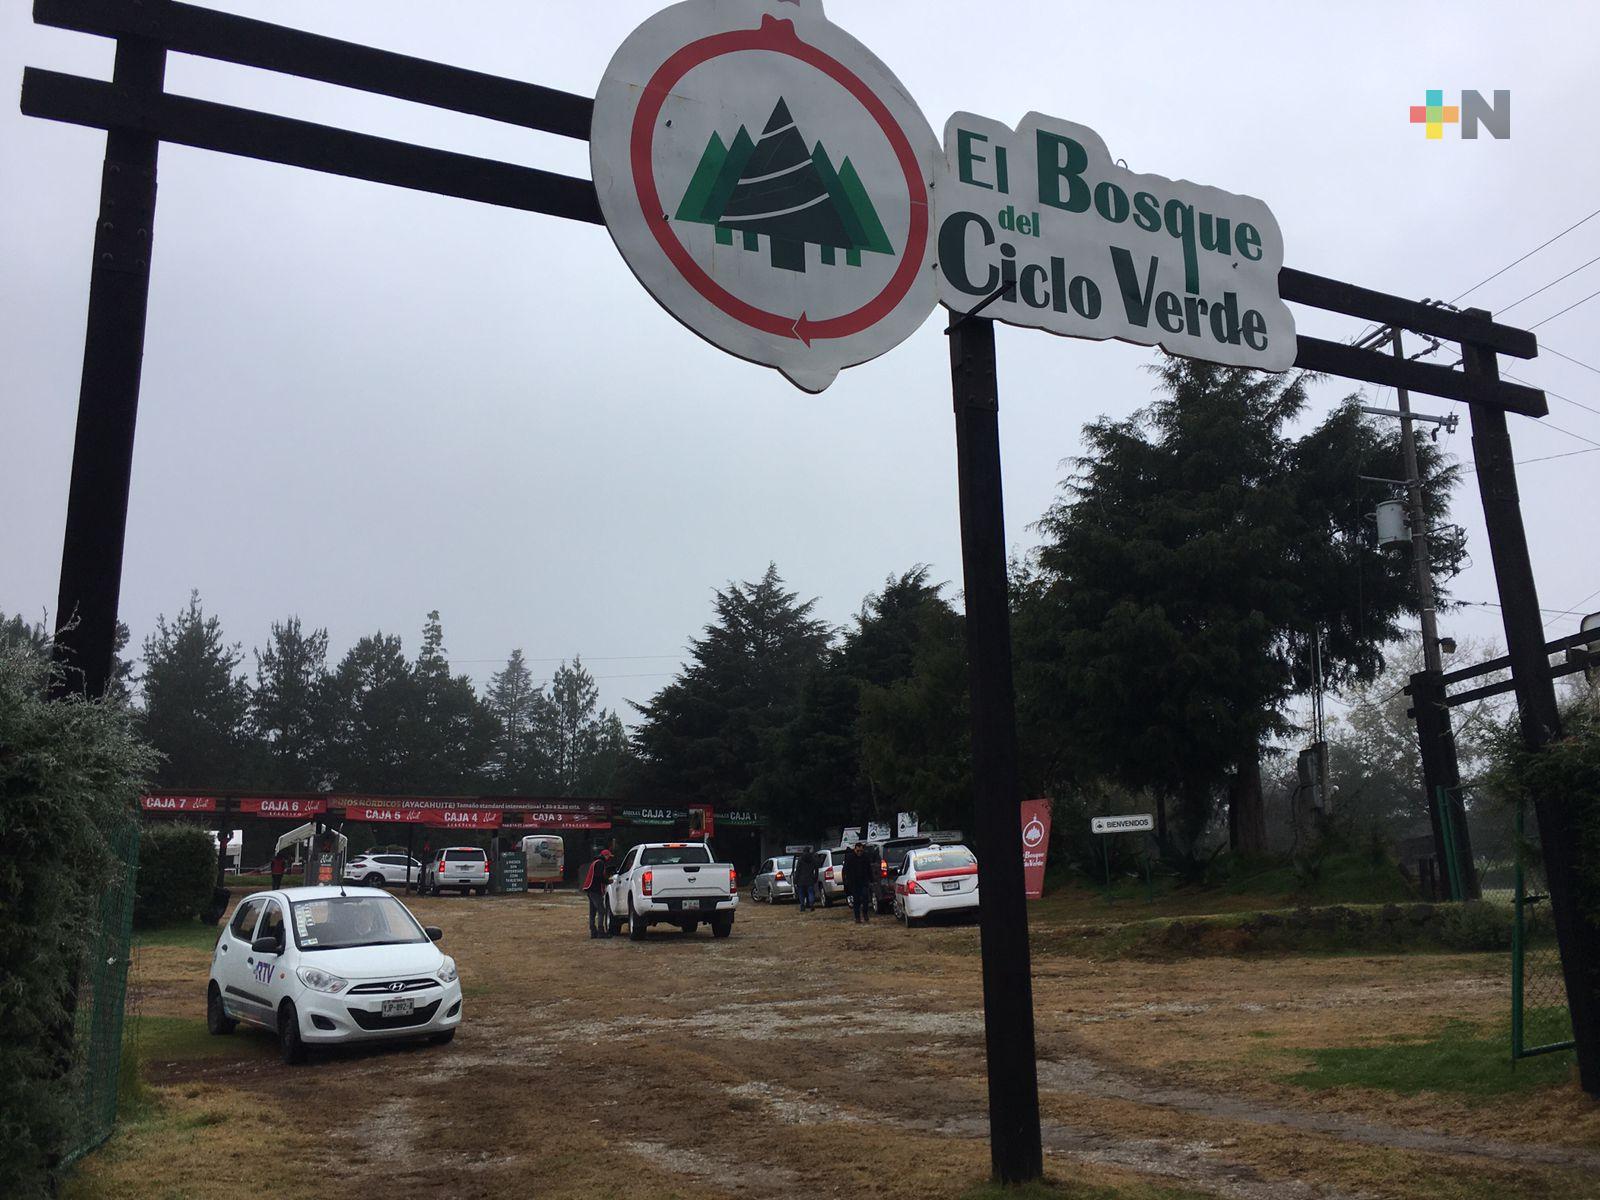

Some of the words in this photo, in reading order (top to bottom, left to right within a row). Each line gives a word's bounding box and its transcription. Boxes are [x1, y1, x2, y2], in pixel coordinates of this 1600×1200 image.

[957, 129, 1008, 195] El
[1036, 128, 1263, 295] Bosque
[998, 205, 1040, 237] del
[938, 211, 1102, 320] Ciclo
[1109, 245, 1269, 351] Verde
[146, 797, 175, 808] CAJA
[179, 799, 186, 808] 7
[261, 800, 288, 811] CAJA
[291, 801, 299, 811] 6
[365, 809, 391, 819] CAJA
[394, 811, 401, 820] 5
[444, 812, 469, 822] CAJA
[471, 812, 478, 822] 4
[532, 812, 555, 821] CAJA
[557, 813, 563, 821] 3
[641, 808, 665, 819] CAJA
[666, 809, 673, 818] 2
[730, 811, 751, 820] CAJA
[1106, 819, 1149, 828] BIENVENIDOS
[254, 961, 275, 984] RTV
